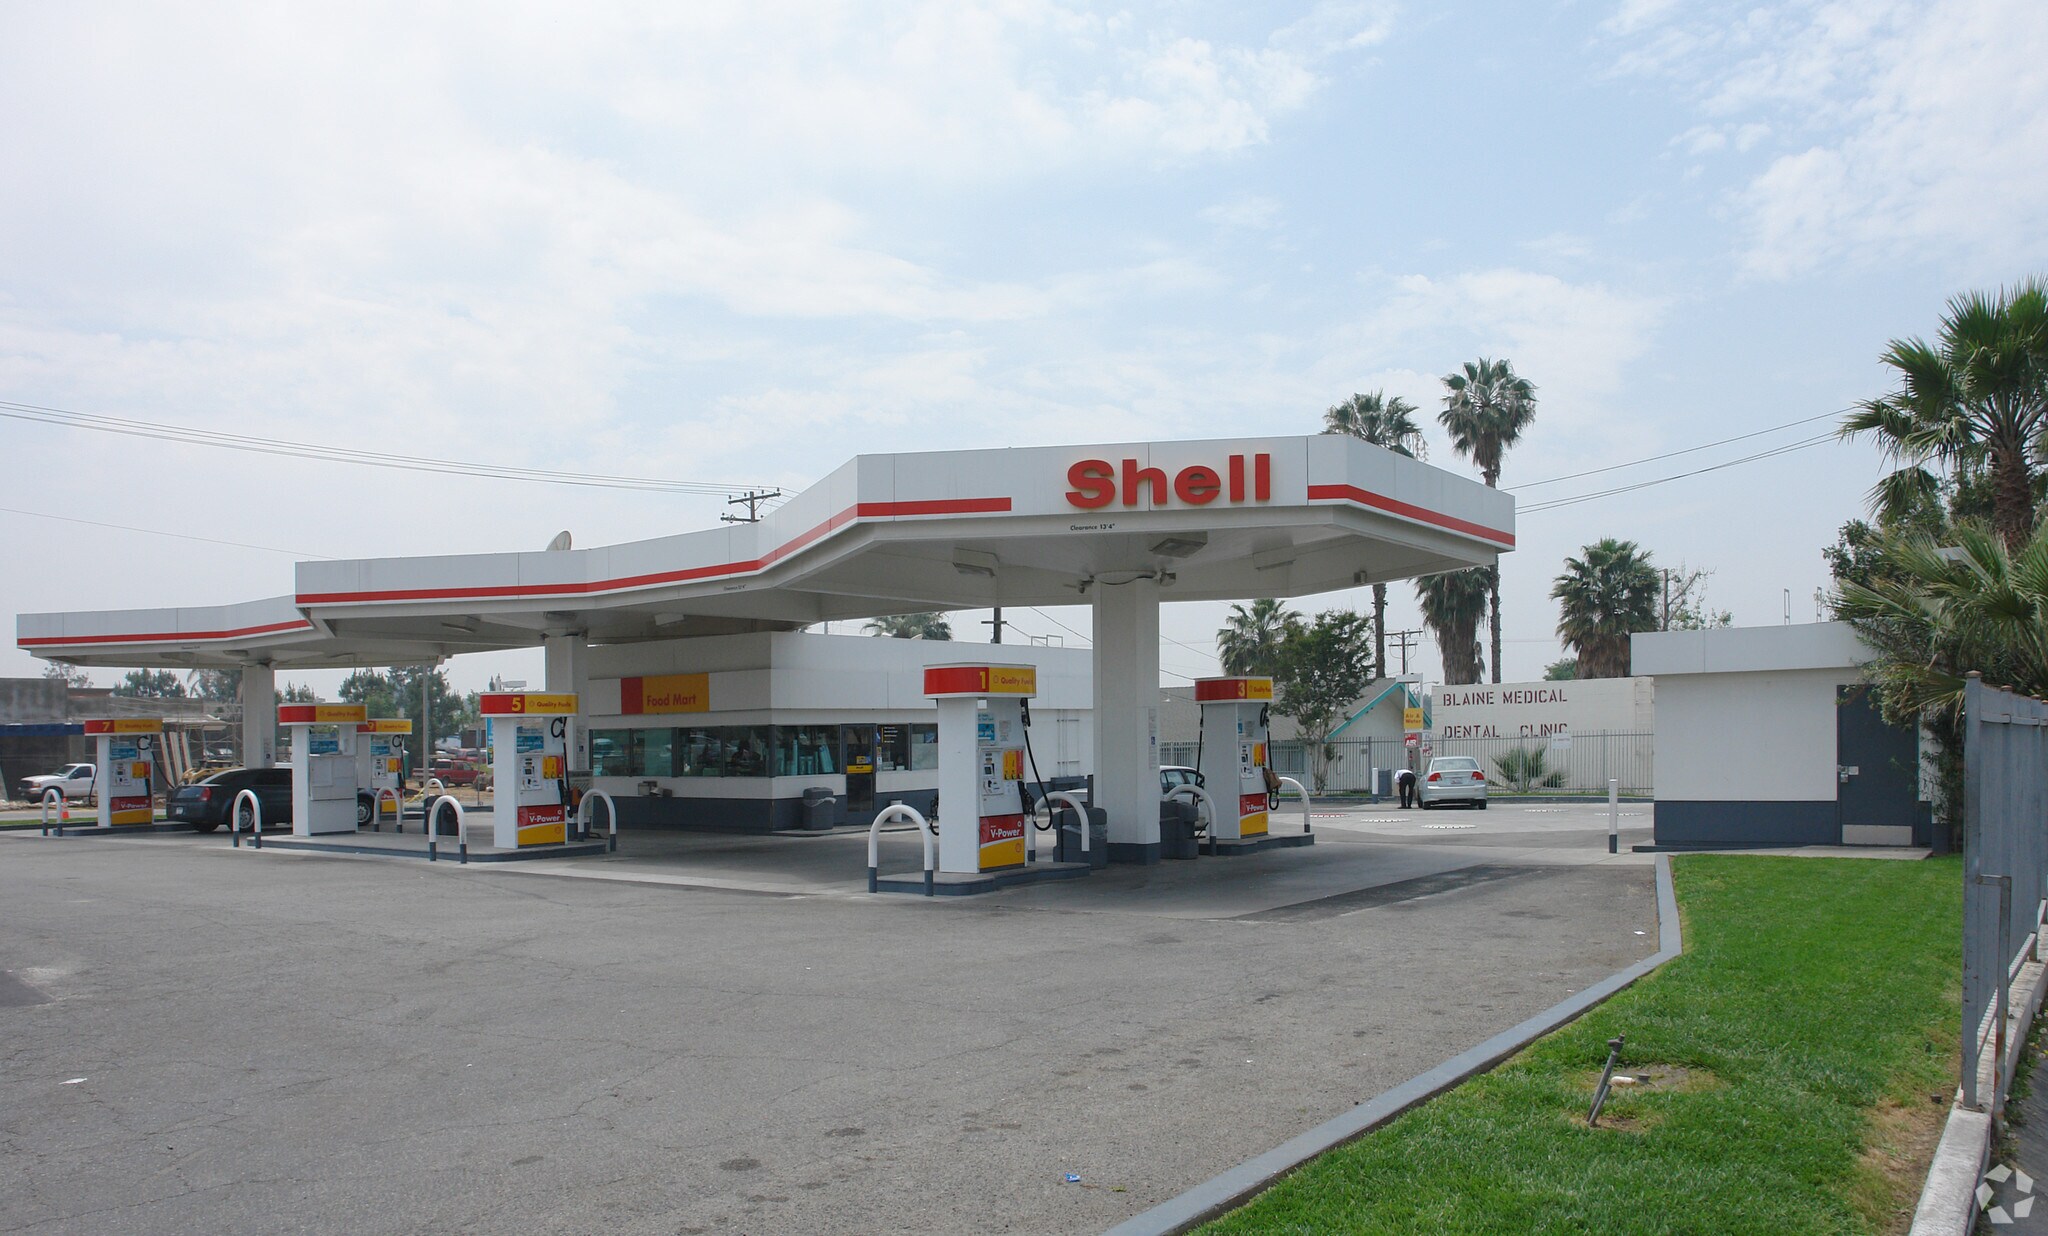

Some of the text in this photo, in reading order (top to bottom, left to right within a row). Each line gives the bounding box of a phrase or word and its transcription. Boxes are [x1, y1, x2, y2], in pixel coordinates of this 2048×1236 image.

[1065, 453, 1270, 508] Shell
[979, 671, 986, 689] 1
[1238, 682, 1245, 697] 3
[511, 697, 522, 711] 5
[647, 693, 697, 706] Food Mart
[1443, 689, 1568, 706] BLAINE MEDICAL
[102, 721, 111, 732] 7
[367, 720, 374, 730] 9
[1444, 723, 1568, 738] DENTAL CLINIC
[529, 815, 560, 823] V-Power
[990, 829, 1020, 839] V-Power
